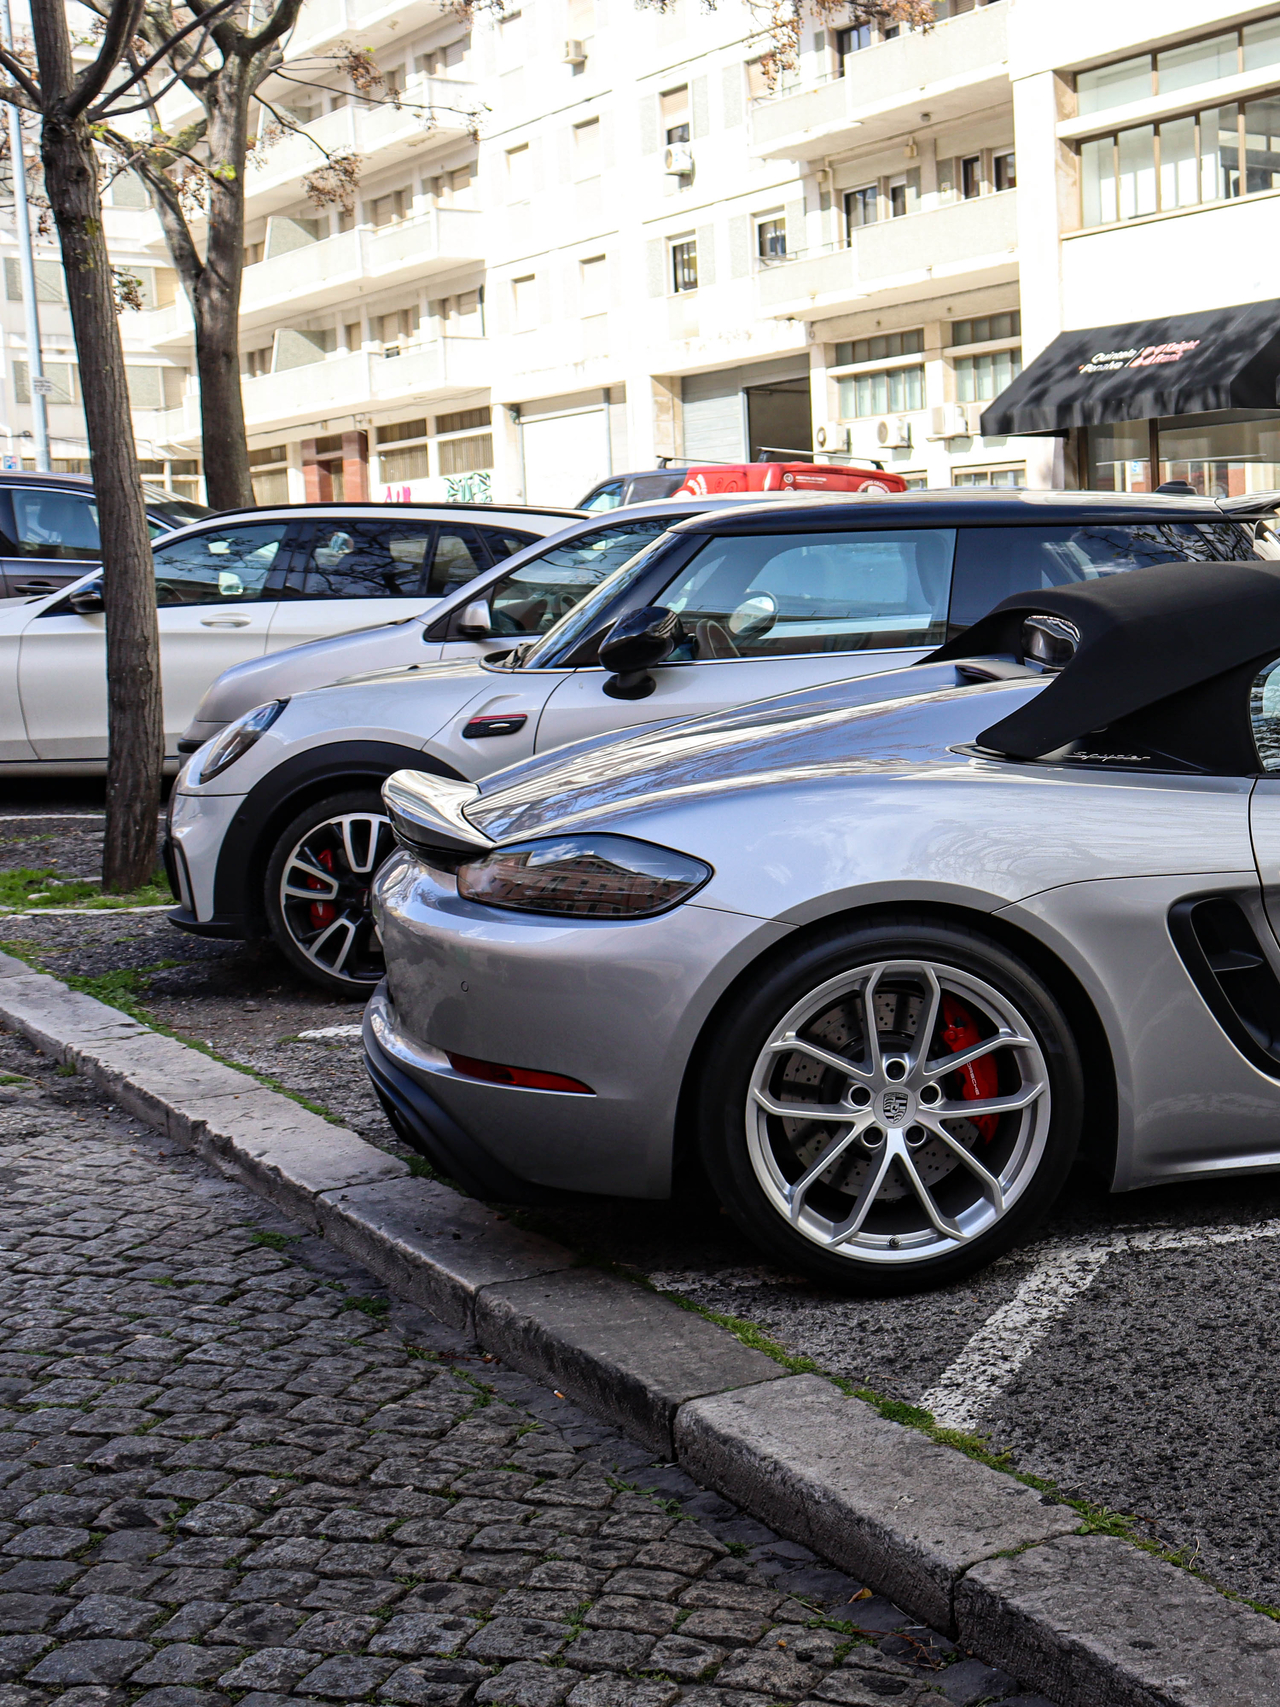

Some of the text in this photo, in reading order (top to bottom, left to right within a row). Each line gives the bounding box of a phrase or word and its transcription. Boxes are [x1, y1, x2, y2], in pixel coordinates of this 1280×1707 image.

[1163, 339, 1200, 352] Knight
[1091, 348, 1138, 365] Quintela
[1152, 350, 1184, 364] Frank
